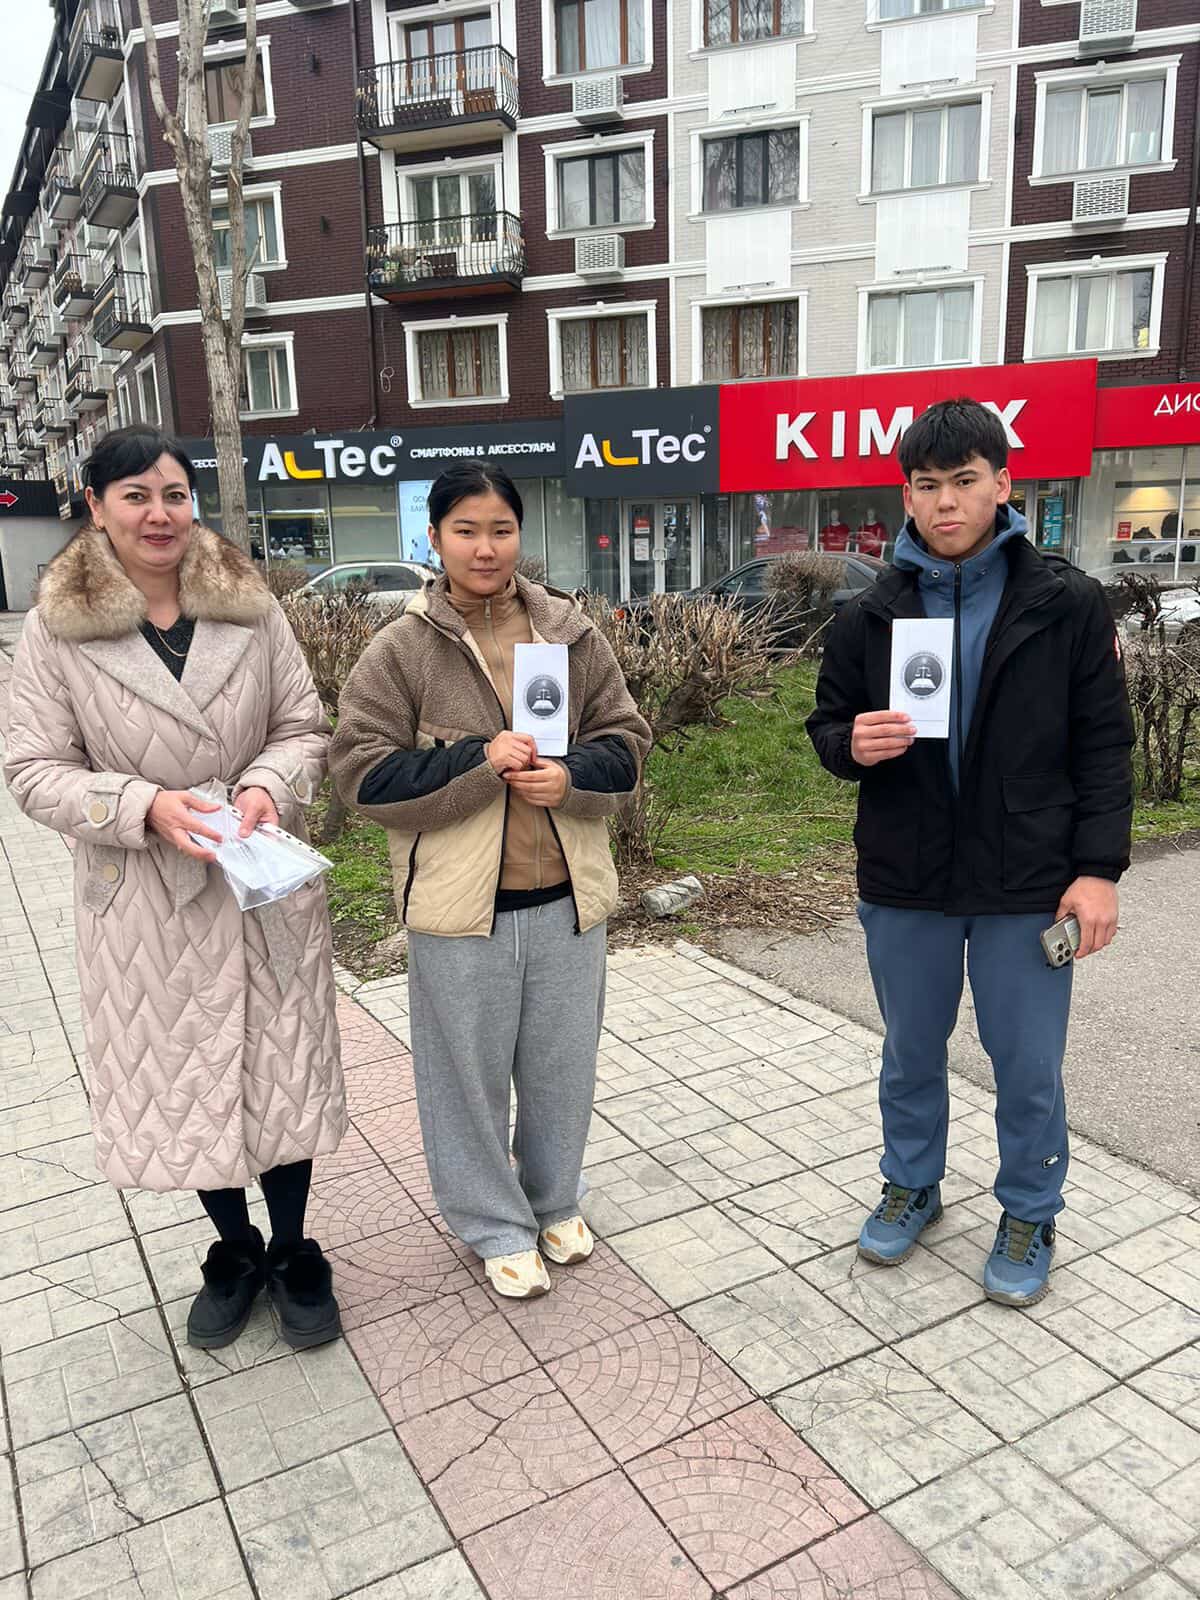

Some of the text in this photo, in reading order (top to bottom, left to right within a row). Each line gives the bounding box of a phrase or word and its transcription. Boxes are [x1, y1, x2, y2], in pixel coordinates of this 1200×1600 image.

[776, 399, 1028, 460] KIMX
[410, 442, 556, 458] СМАРТФОНЫ & АКСЕССУАРЫ
